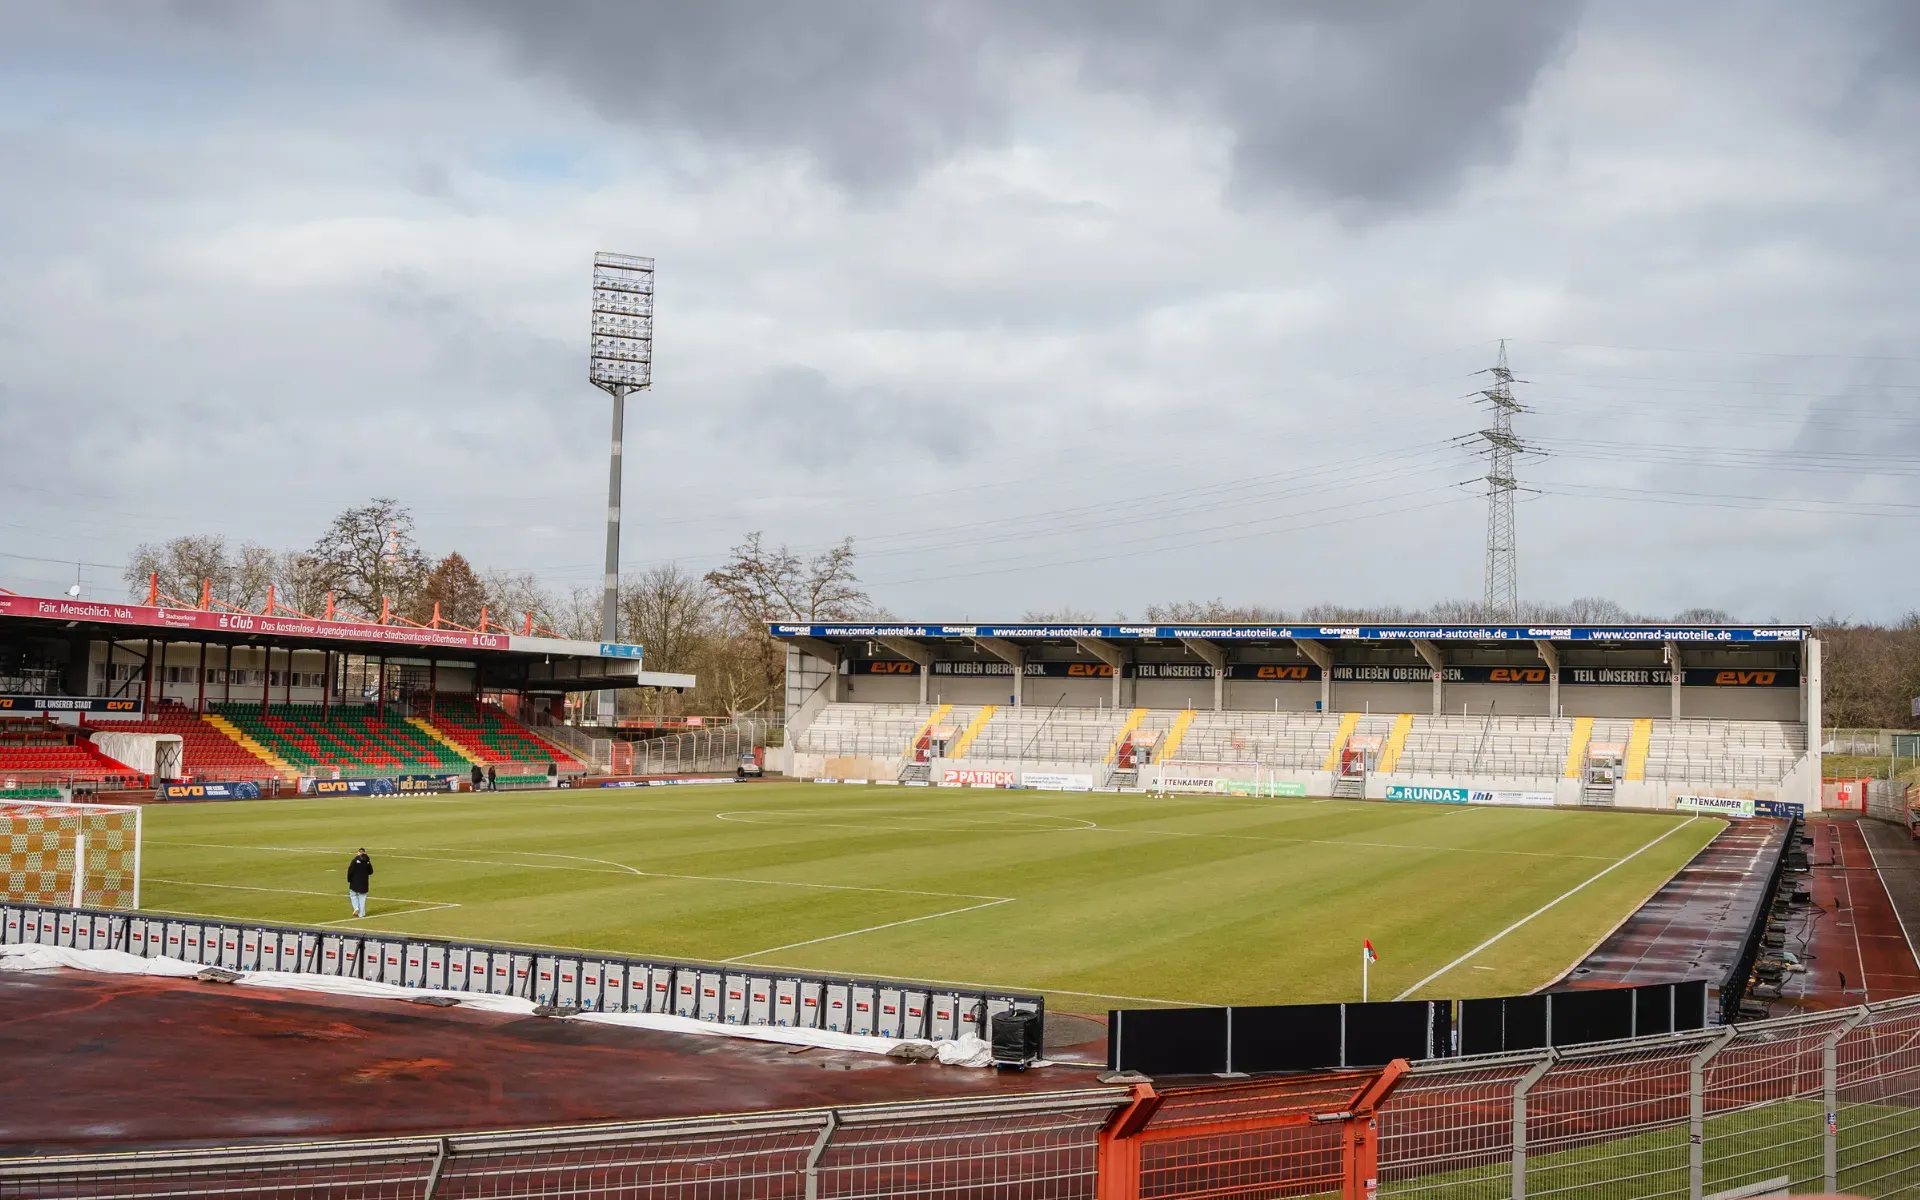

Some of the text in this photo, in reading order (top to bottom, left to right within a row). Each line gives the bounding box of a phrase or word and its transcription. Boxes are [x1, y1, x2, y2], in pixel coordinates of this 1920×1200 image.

[39, 602, 133, 619] Fair. Menschlich. Nah.
[230, 616, 253, 629] Club
[261, 620, 467, 645] Das kostenlose Jugendgirokonto der Stadtsparkasse Oberhausen
[779, 625, 810, 633] Conrad
[825, 626, 927, 635] www.conrad-autoteile.de
[993, 627, 1102, 636] www.conrad-autoteile.de
[1174, 627, 1292, 637] www.conrad-autoteile.de
[1320, 627, 1359, 635] Conrad
[1379, 628, 1507, 639] www.conrad-autoteile.de
[1528, 628, 1571, 636] Conrad
[1592, 629, 1731, 640] www.conrad-autoteile.de
[1753, 629, 1800, 637] Conrad
[480, 635, 497, 646] Club
[870, 662, 914, 673] evo
[935, 662, 1046, 675] WIR LIEBEN OBERHSEN.
[1068, 663, 1113, 676] evo
[1138, 665, 1233, 677] TEIL UNSERER STT
[1257, 666, 1308, 678] evo
[1333, 667, 1464, 681] WIR LIEBEN OBERHASEN.
[1489, 669, 1546, 682] evo
[1573, 670, 1686, 683] TEIL UNSERER STAT
[1715, 671, 1778, 685] evo
[35, 700, 92, 709] TEIL UNSERER STADT
[107, 701, 134, 710] evo
[959, 771, 1014, 784] PATRICK
[1152, 778, 1214, 787] NTTENKAMPER
[168, 785, 204, 797] evo
[318, 782, 348, 792] evo
[1404, 788, 1460, 801] RUNDAS
[1472, 792, 1493, 801] ihb
